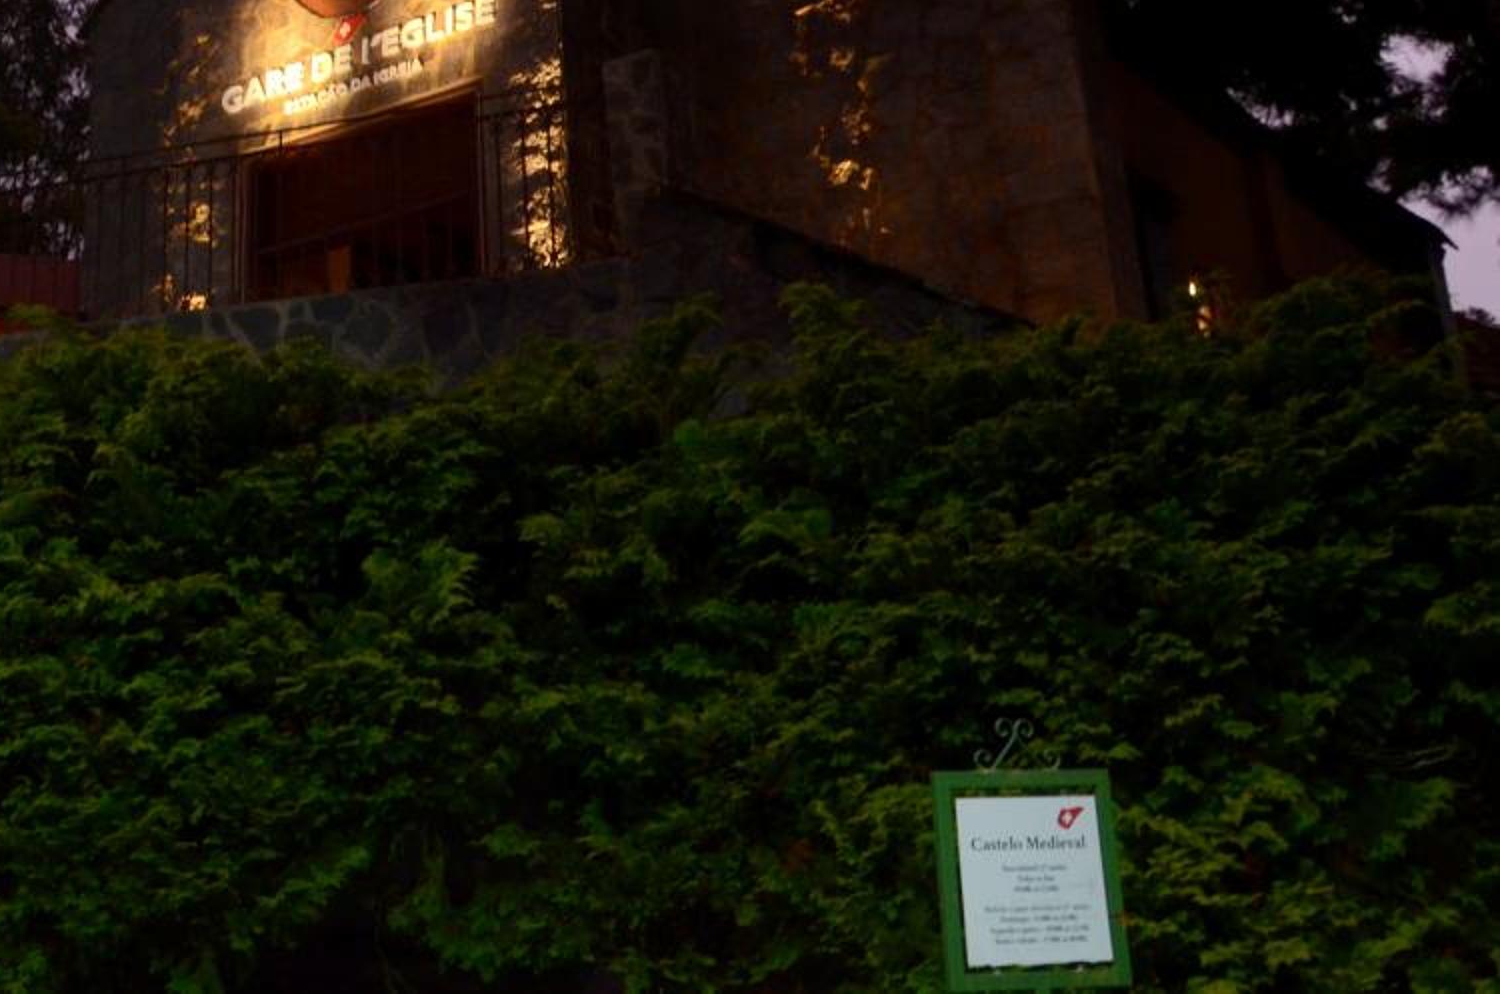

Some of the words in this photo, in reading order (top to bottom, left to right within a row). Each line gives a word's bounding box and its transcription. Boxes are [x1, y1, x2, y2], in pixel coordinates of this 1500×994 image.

[221, 61, 304, 115] GARE
[311, 43, 352, 84] DE
[350, 74, 372, 93] DA
[971, 836, 1023, 852] Castelo
[1026, 835, 1086, 851] Medieval
